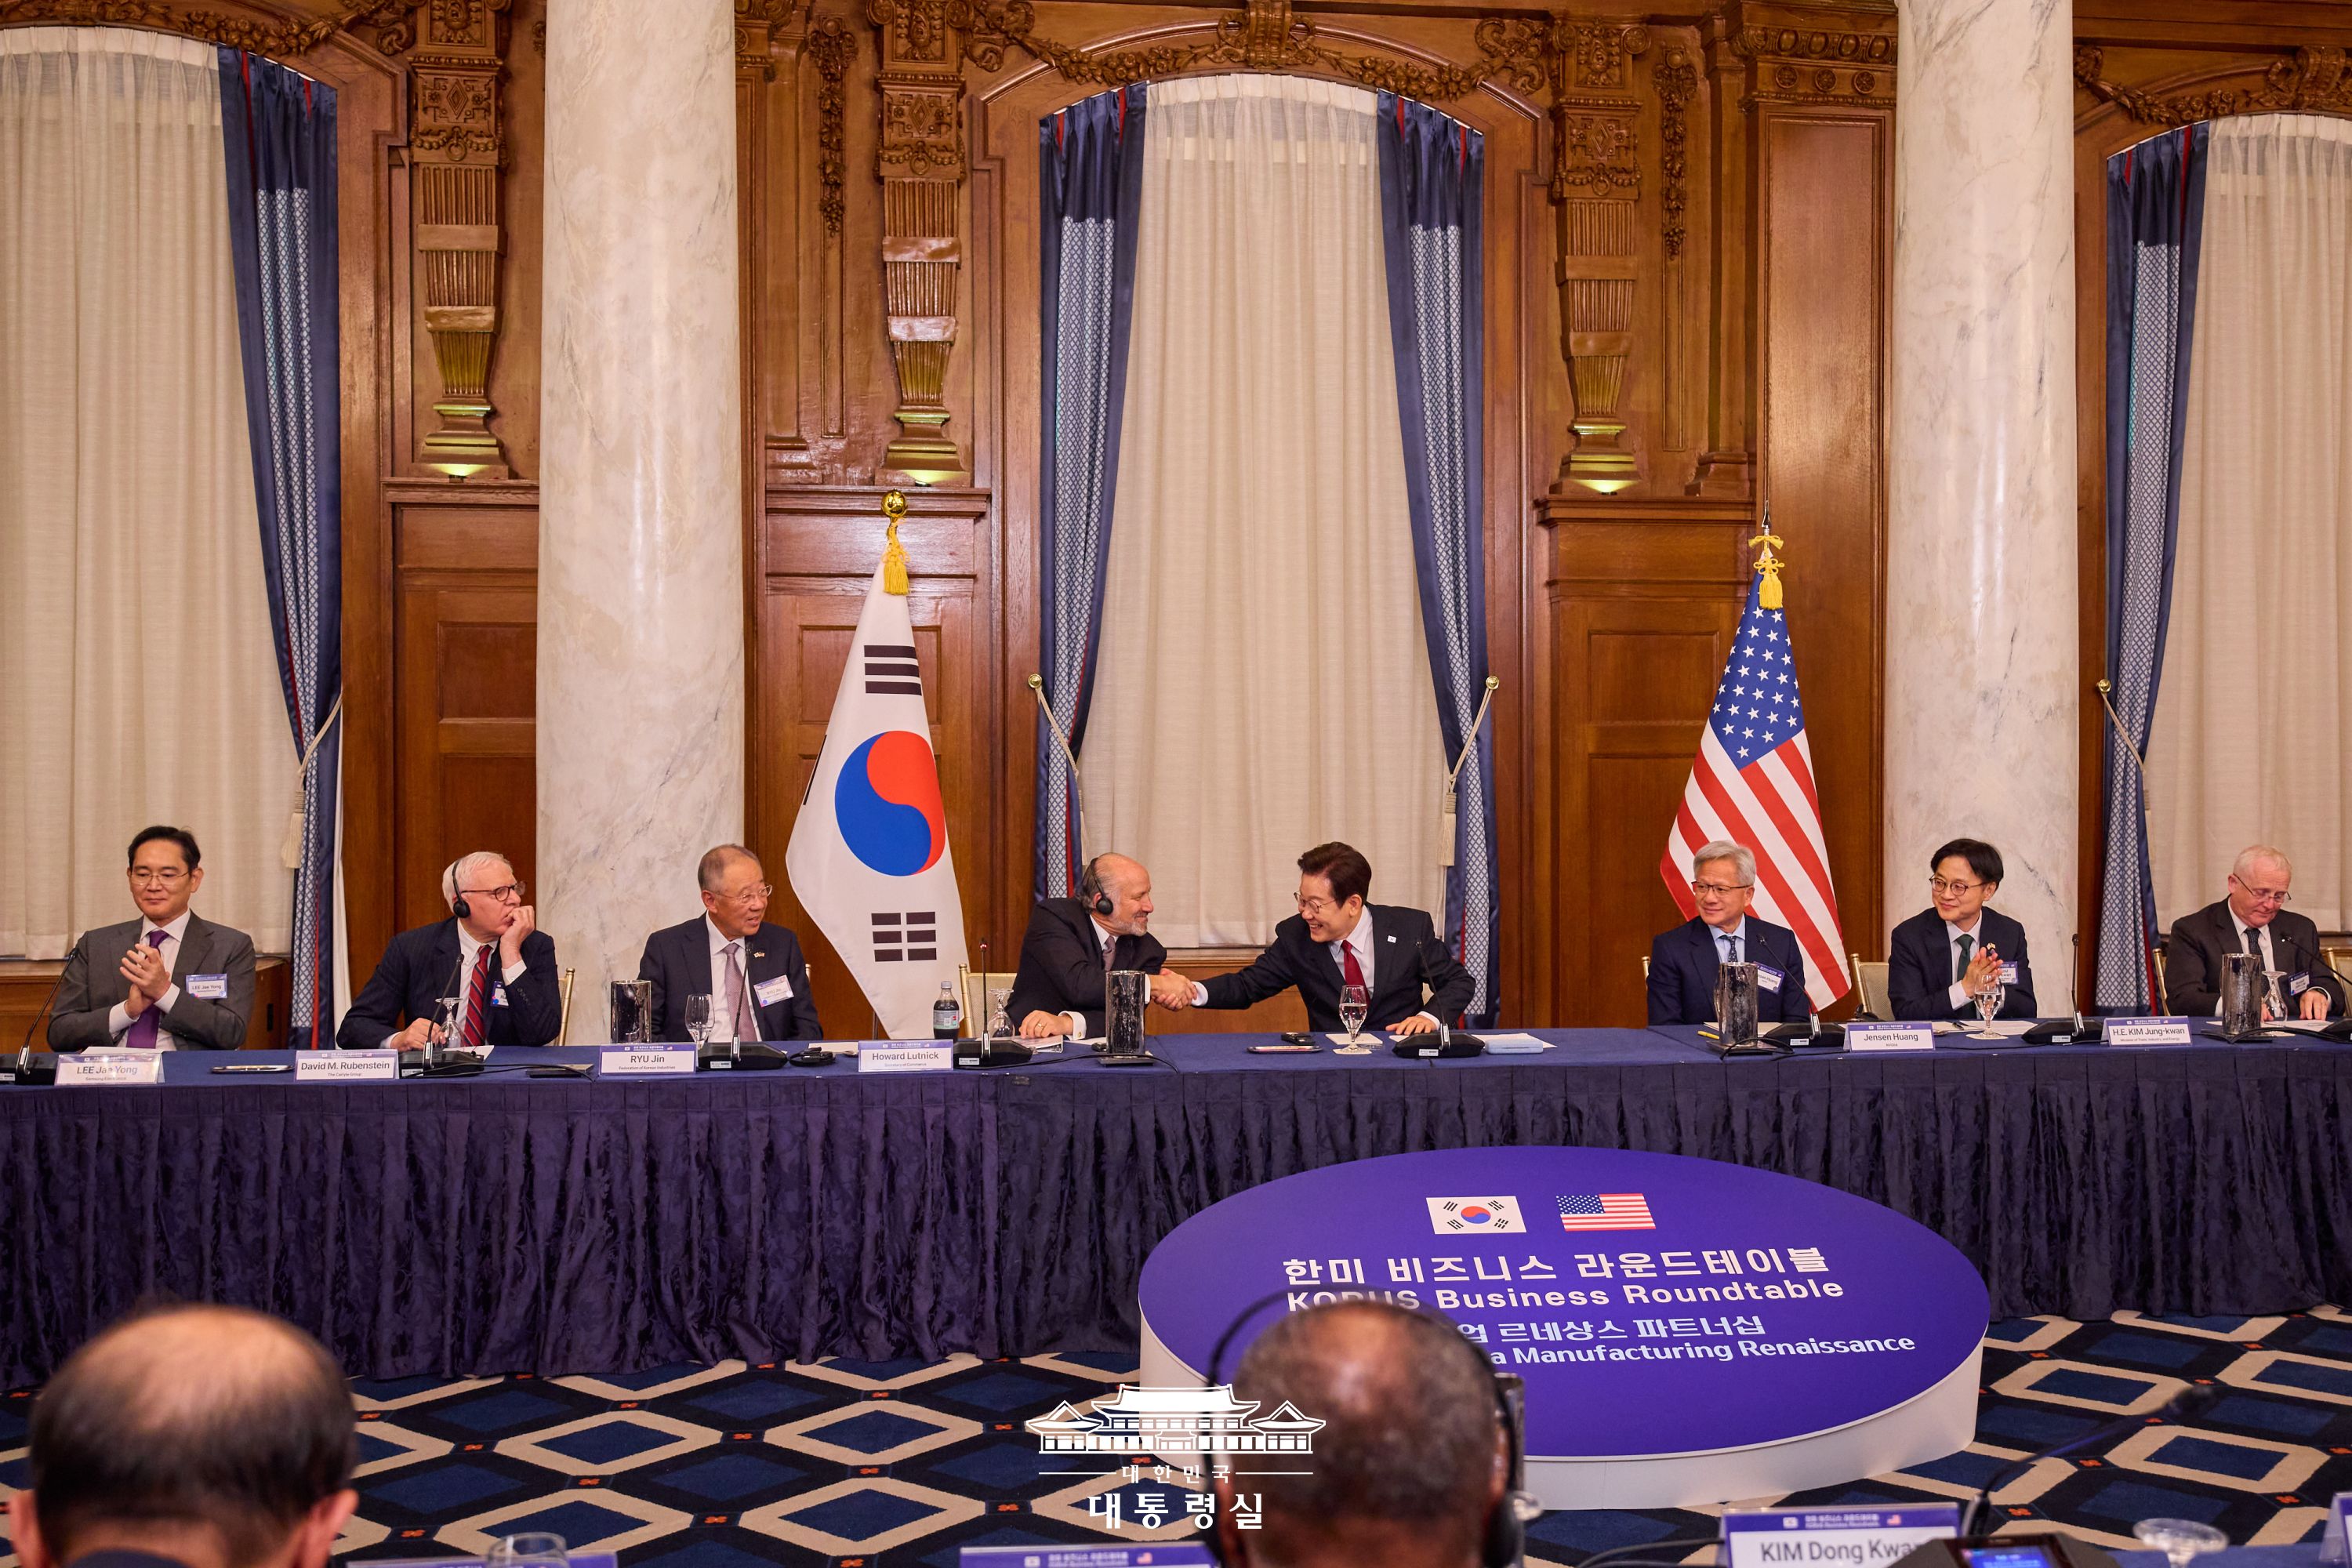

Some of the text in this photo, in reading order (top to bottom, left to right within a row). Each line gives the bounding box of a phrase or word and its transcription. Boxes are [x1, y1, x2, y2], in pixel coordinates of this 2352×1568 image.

[2144, 1027, 2185, 1036] Jung-kwan
[906, 1051, 939, 1060] Lutnick
[115, 1066, 138, 1075] Yong
[1283, 1247, 1829, 1285] 한미 비즈니스 라운드테이블
[1436, 1287, 1610, 1309] Business
[1622, 1279, 1844, 1305] Roundtable
[1498, 1320, 1628, 1342] 르네상스
[1633, 1316, 1766, 1338] 파트너십
[1512, 1340, 1733, 1365] Manufacturing
[1738, 1337, 1915, 1357] Renaissance
[1760, 1538, 1919, 1565] KIM Dong Kwa
